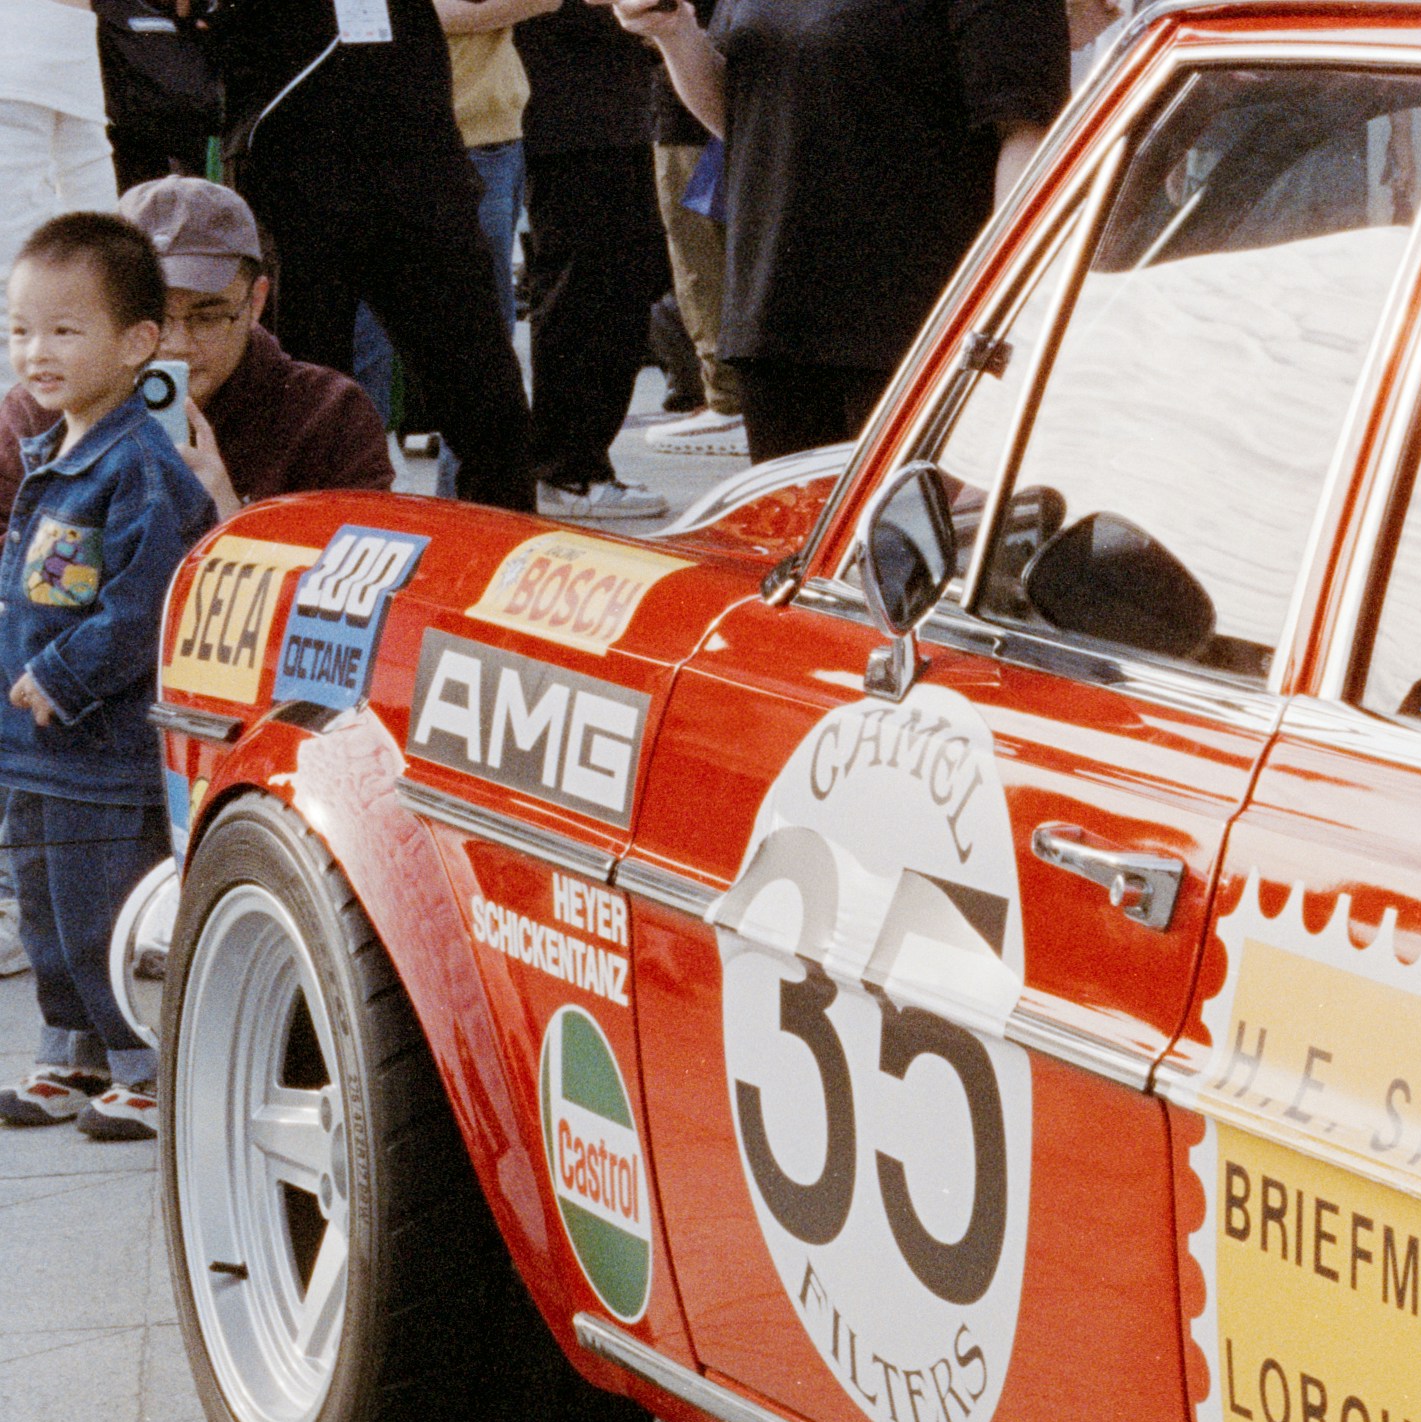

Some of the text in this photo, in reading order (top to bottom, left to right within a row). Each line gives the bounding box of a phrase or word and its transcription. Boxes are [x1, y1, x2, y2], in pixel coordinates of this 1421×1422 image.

[180, 557, 277, 669] SECA
[296, 534, 416, 622] 100
[503, 557, 644, 640] BOSCH
[283, 635, 363, 689] OCTANE
[414, 649, 640, 812] AMG
[810, 706, 985, 863] CAMEL
[471, 894, 628, 1005] SCHICKENTANZ
[553, 873, 628, 946] HEYER
[714, 826, 1009, 1306] 35
[558, 1117, 640, 1223] Castrol
